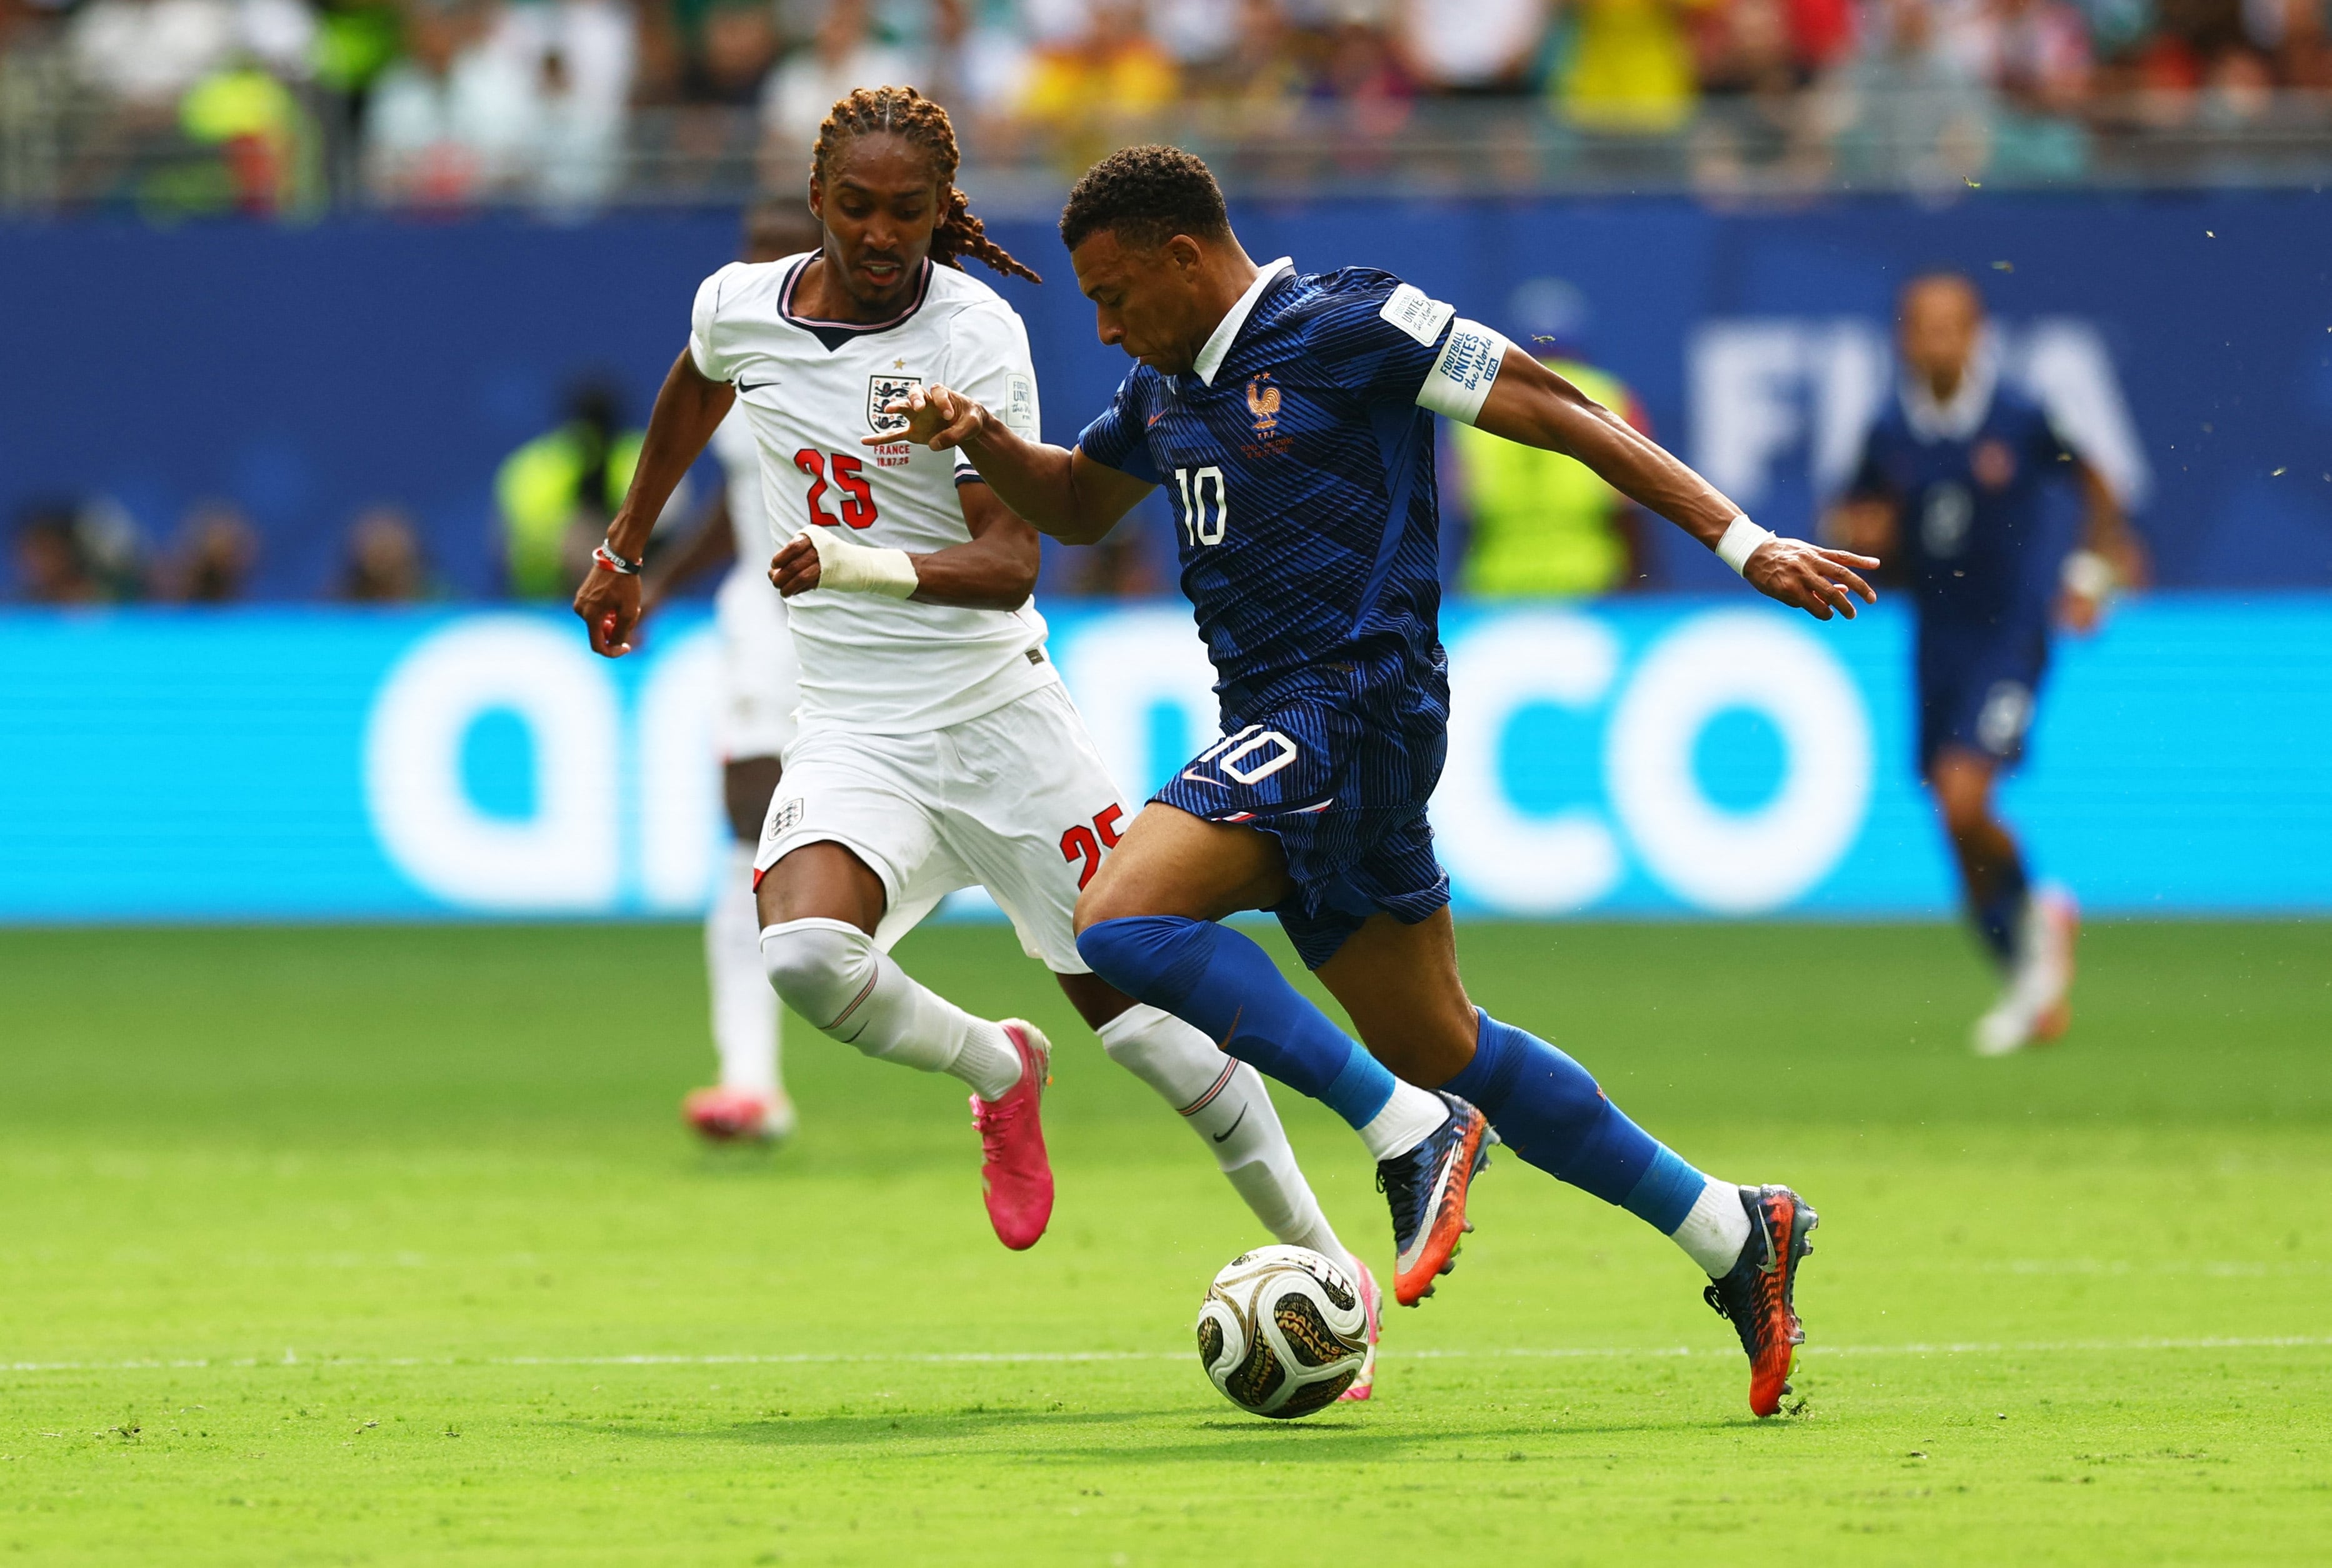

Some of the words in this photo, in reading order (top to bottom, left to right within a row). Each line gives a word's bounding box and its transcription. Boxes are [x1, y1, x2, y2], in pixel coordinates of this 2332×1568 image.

[1427, 314, 1438, 327] FIFA
[1439, 331, 1465, 376] FOOTBALL
[1449, 334, 1479, 382] UNITES
[1464, 370, 1479, 391] the
[1472, 336, 1494, 372] World
[1484, 358, 1498, 381] FIFA
[1690, 318, 2149, 506] FIA
[874, 444, 911, 455] FRANCE
[794, 448, 878, 530] 25
[1175, 466, 1227, 546] 10
[365, 610, 1871, 913] arco
[1198, 724, 1298, 786] 10
[1278, 1319, 1338, 1363] MIAMI
[1283, 1310, 1341, 1355] DALLAS
